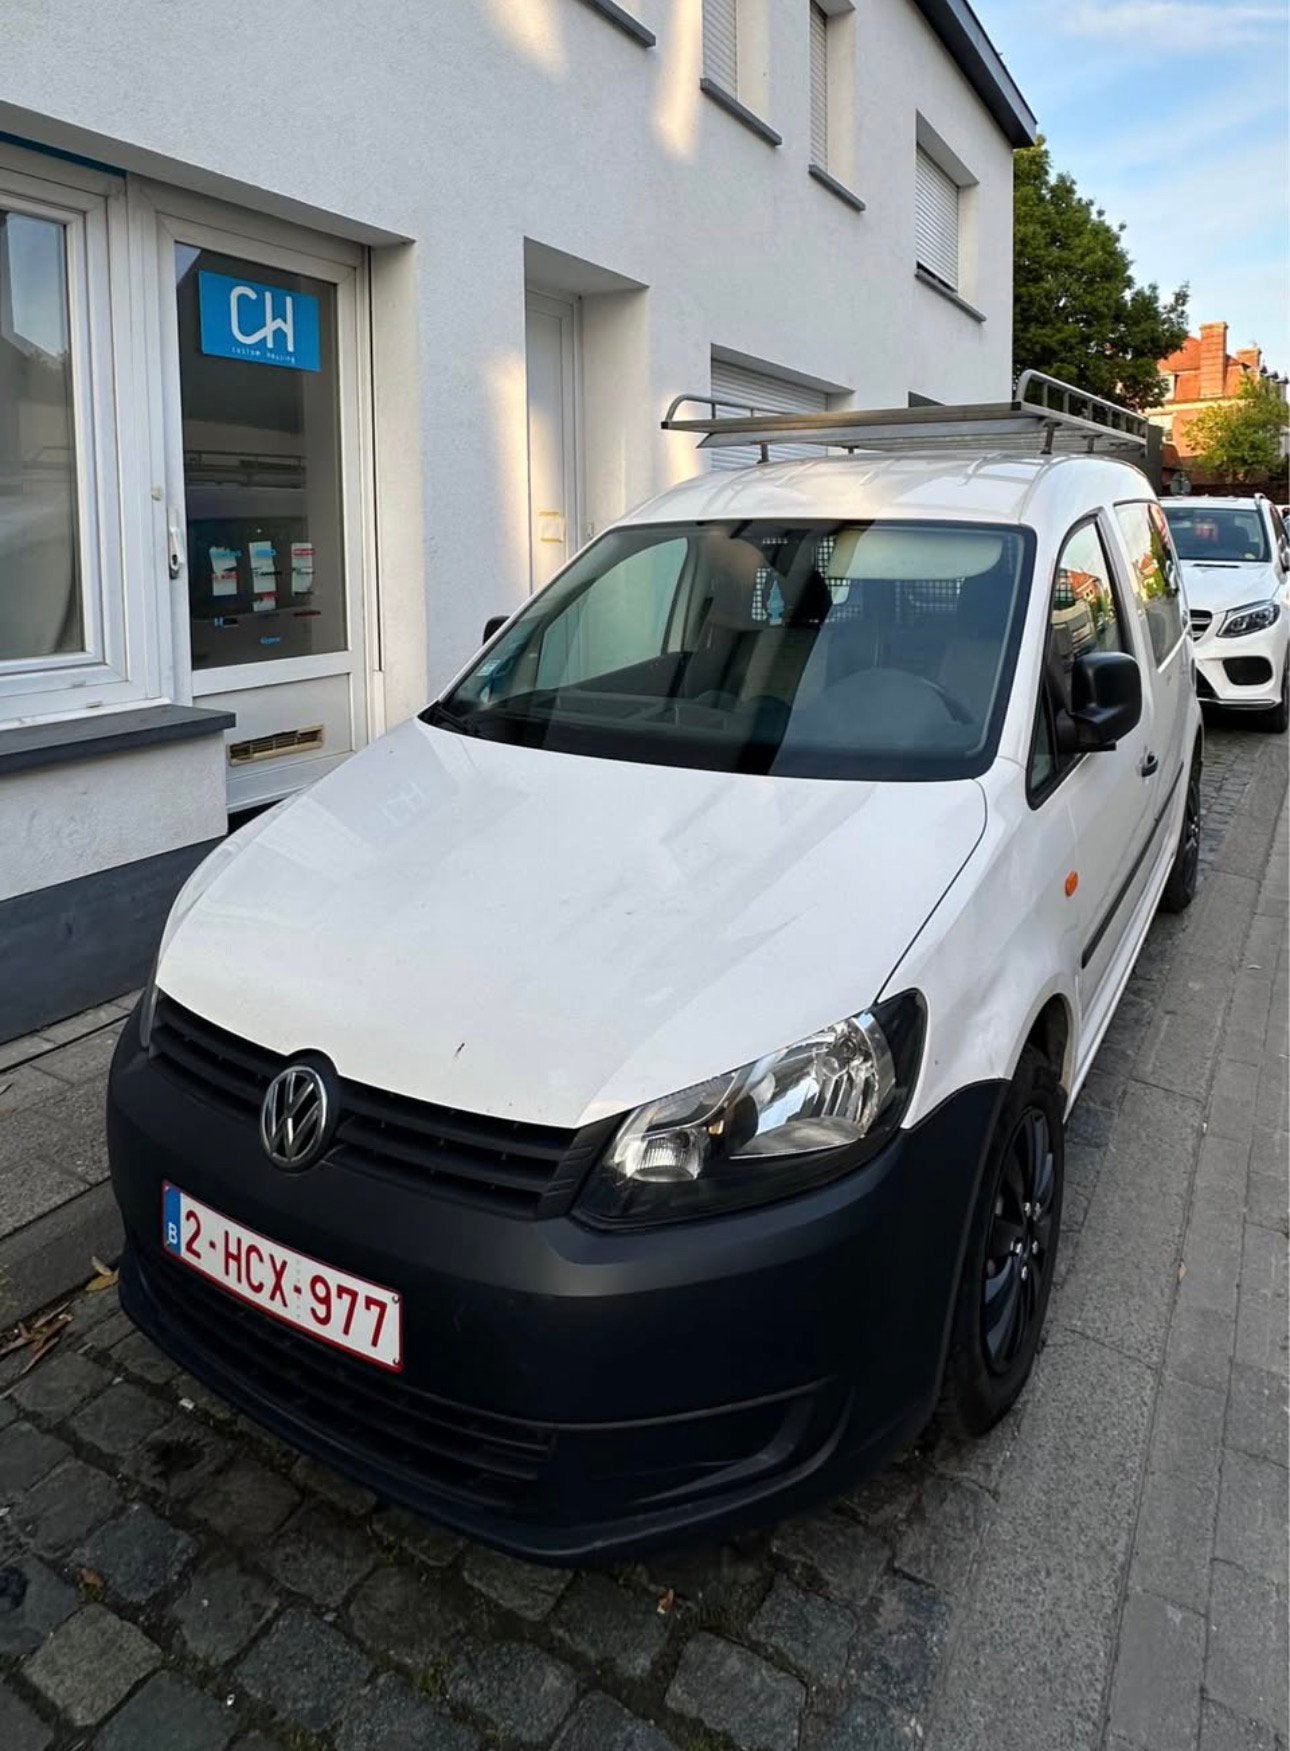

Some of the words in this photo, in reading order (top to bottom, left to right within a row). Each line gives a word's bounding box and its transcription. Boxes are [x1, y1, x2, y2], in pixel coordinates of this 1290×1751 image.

[230, 285, 294, 352] CH
[167, 1221, 178, 1245] B
[184, 1209, 389, 1349] 2-HCX-977
